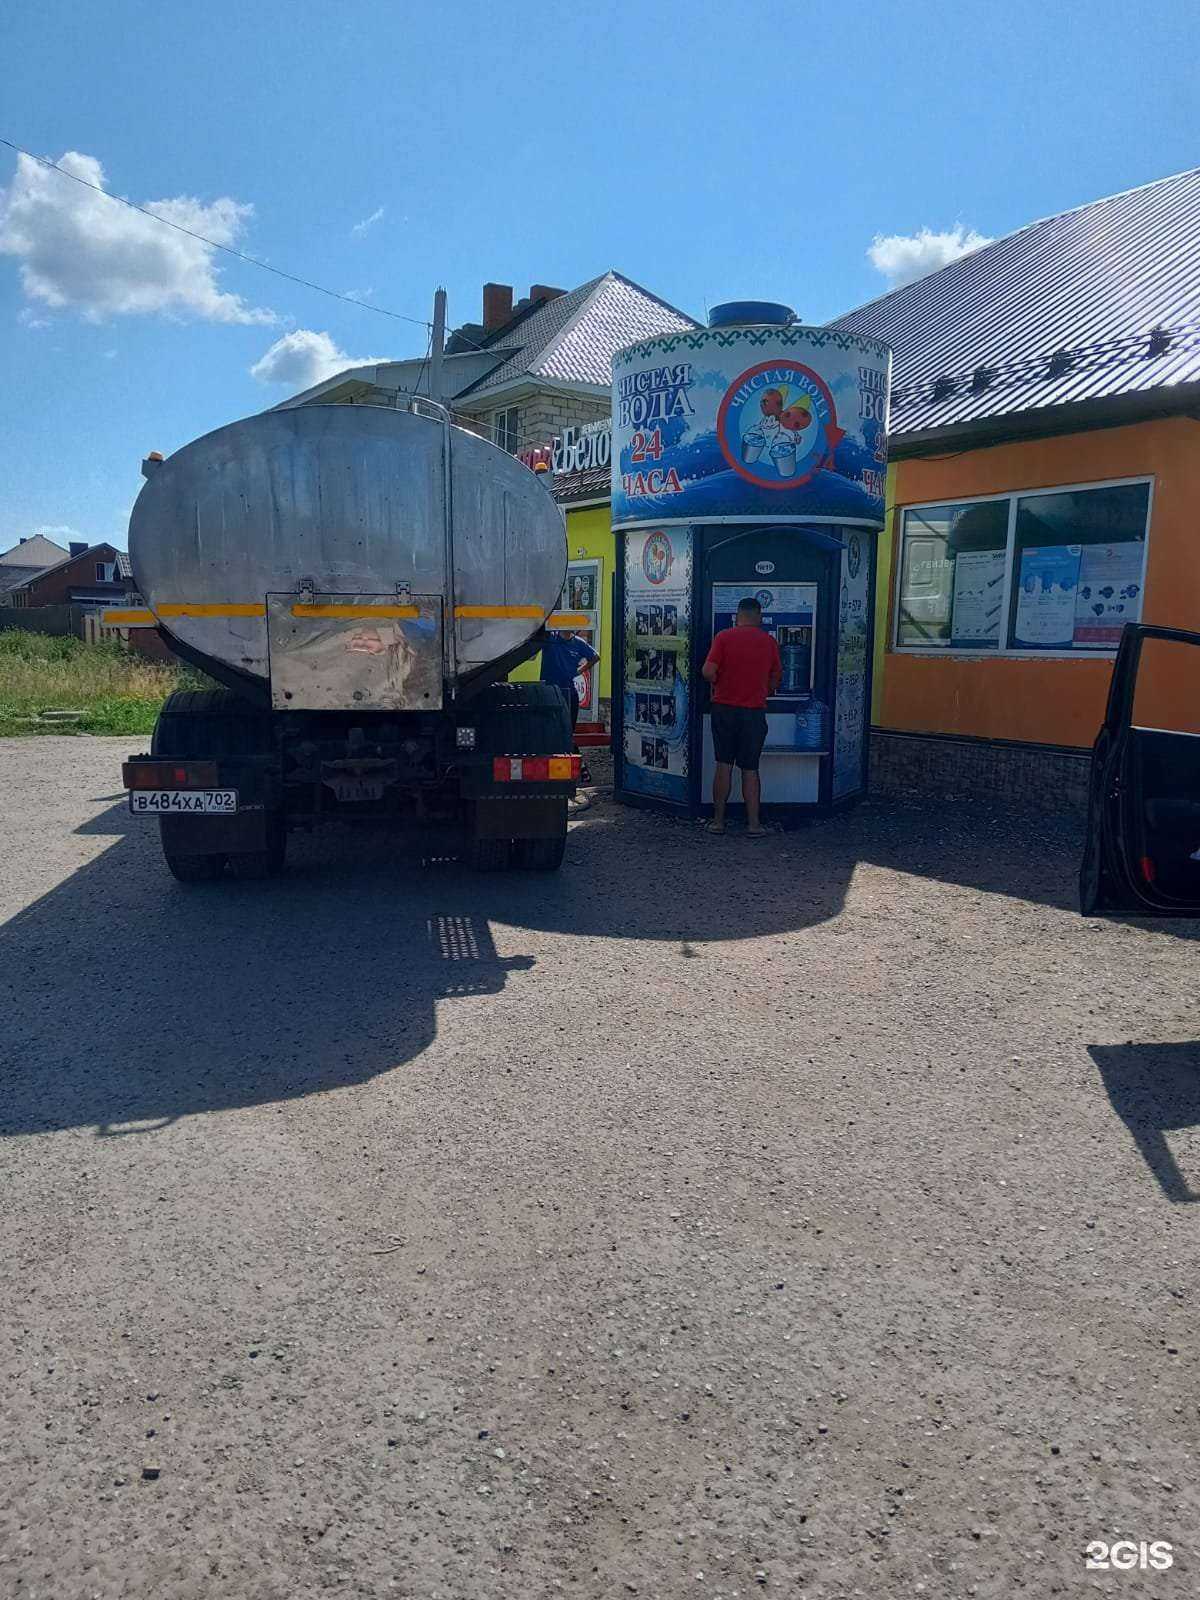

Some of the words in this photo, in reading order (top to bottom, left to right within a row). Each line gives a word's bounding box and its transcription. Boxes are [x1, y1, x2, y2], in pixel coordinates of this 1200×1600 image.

[619, 364, 691, 397] ЧИСТАЯ
[730, 368, 795, 407] ЧИСТАЯ
[859, 367, 887, 394] ЧИС
[619, 388, 695, 428] ВОДА
[859, 391, 886, 423] ВО
[631, 427, 664, 463] 24
[622, 467, 685, 498] ЧАСА
[206, 793, 231, 806] 702
